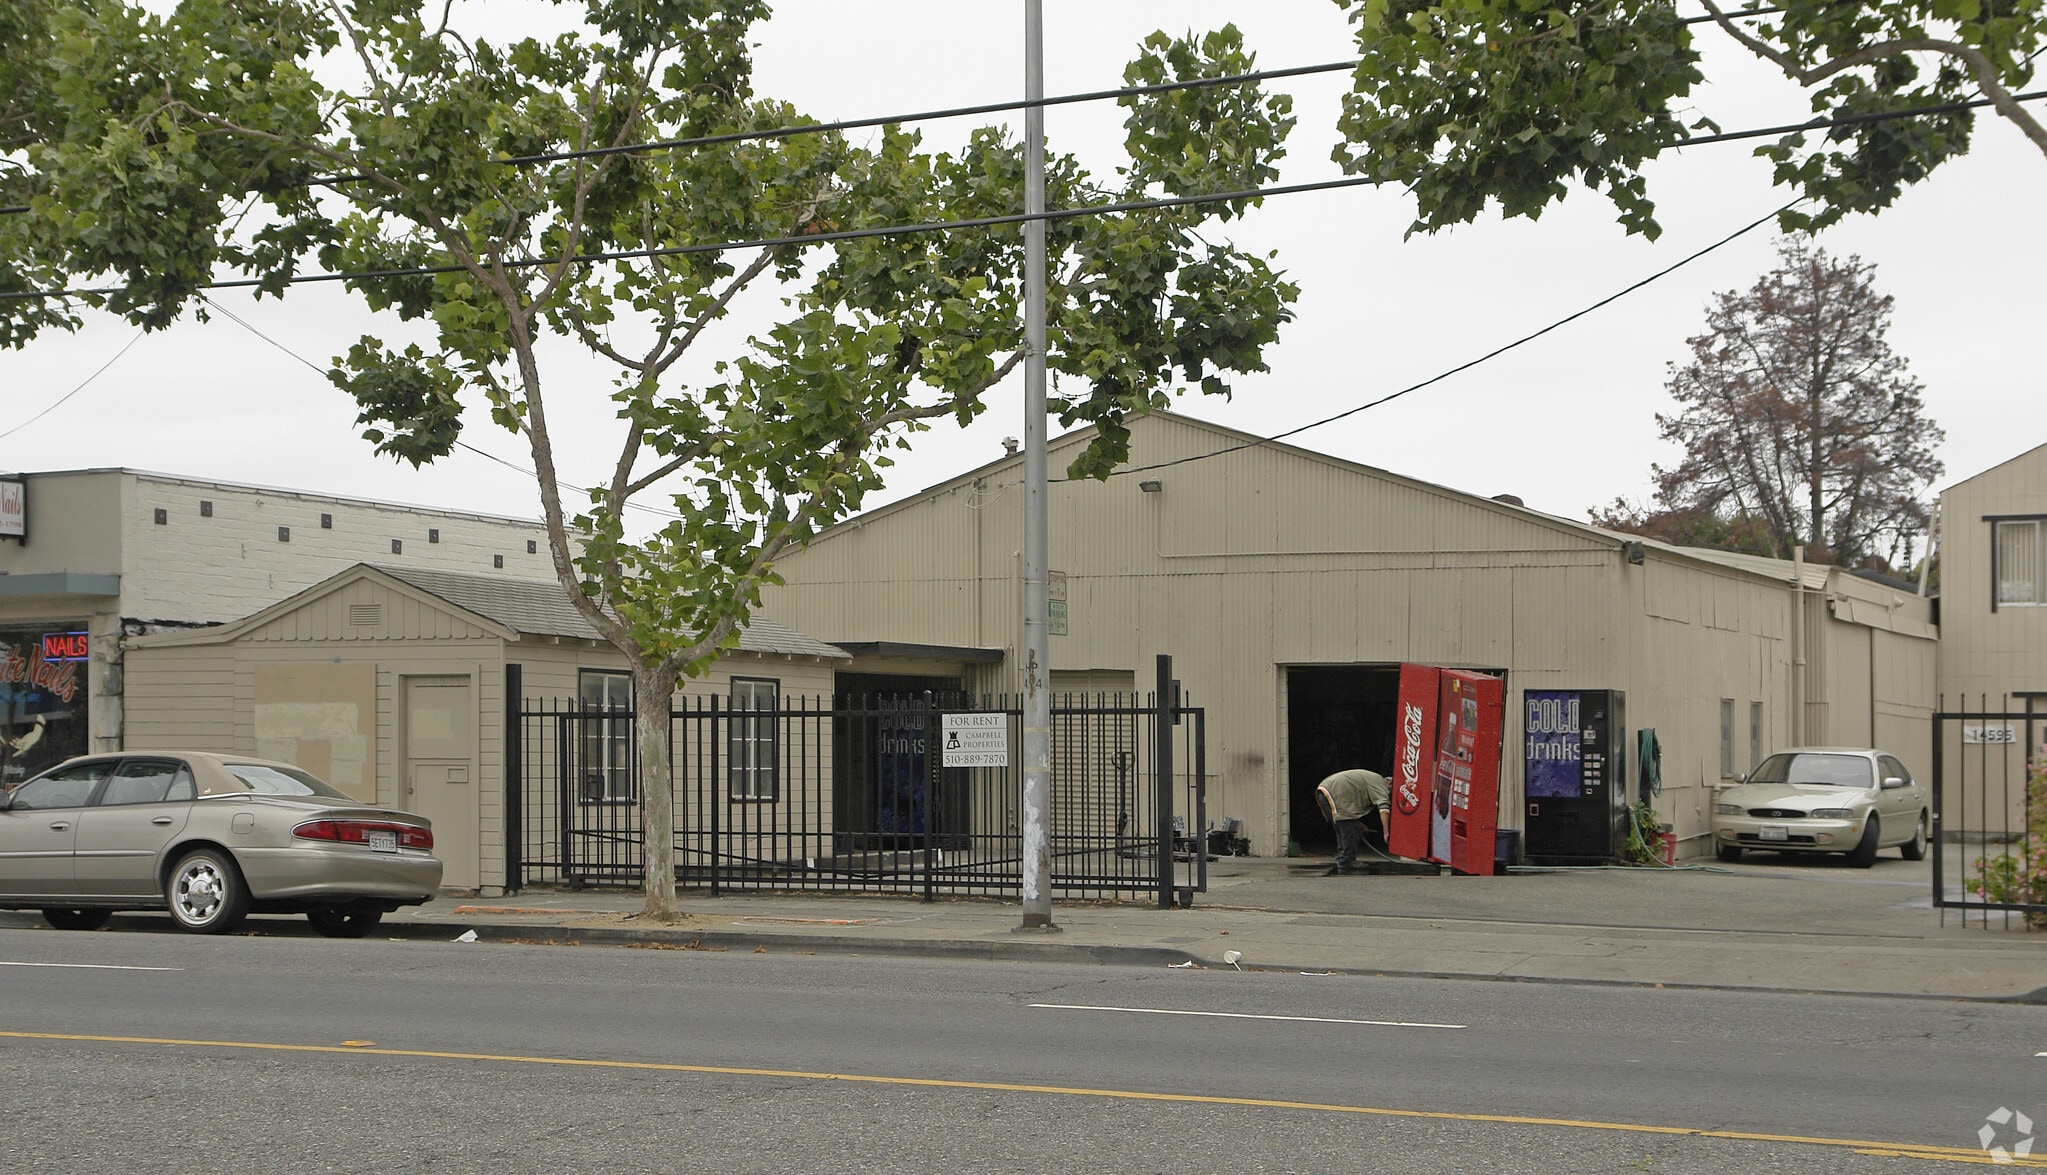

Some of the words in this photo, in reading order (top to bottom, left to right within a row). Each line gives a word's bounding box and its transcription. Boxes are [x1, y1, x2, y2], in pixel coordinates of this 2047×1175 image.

[45, 635, 87, 657] NAILS
[23, 642, 79, 703] Nails
[880, 699, 925, 730] COLD
[950, 716, 970, 726] FOR
[973, 716, 1000, 726] RENT
[1526, 698, 1581, 734] COLD
[963, 740, 1005, 748] PROPERTIES
[965, 732, 1002, 740] CAMPBELL
[1526, 735, 1581, 761] drinks
[945, 754, 1005, 765] 510-889-7870
